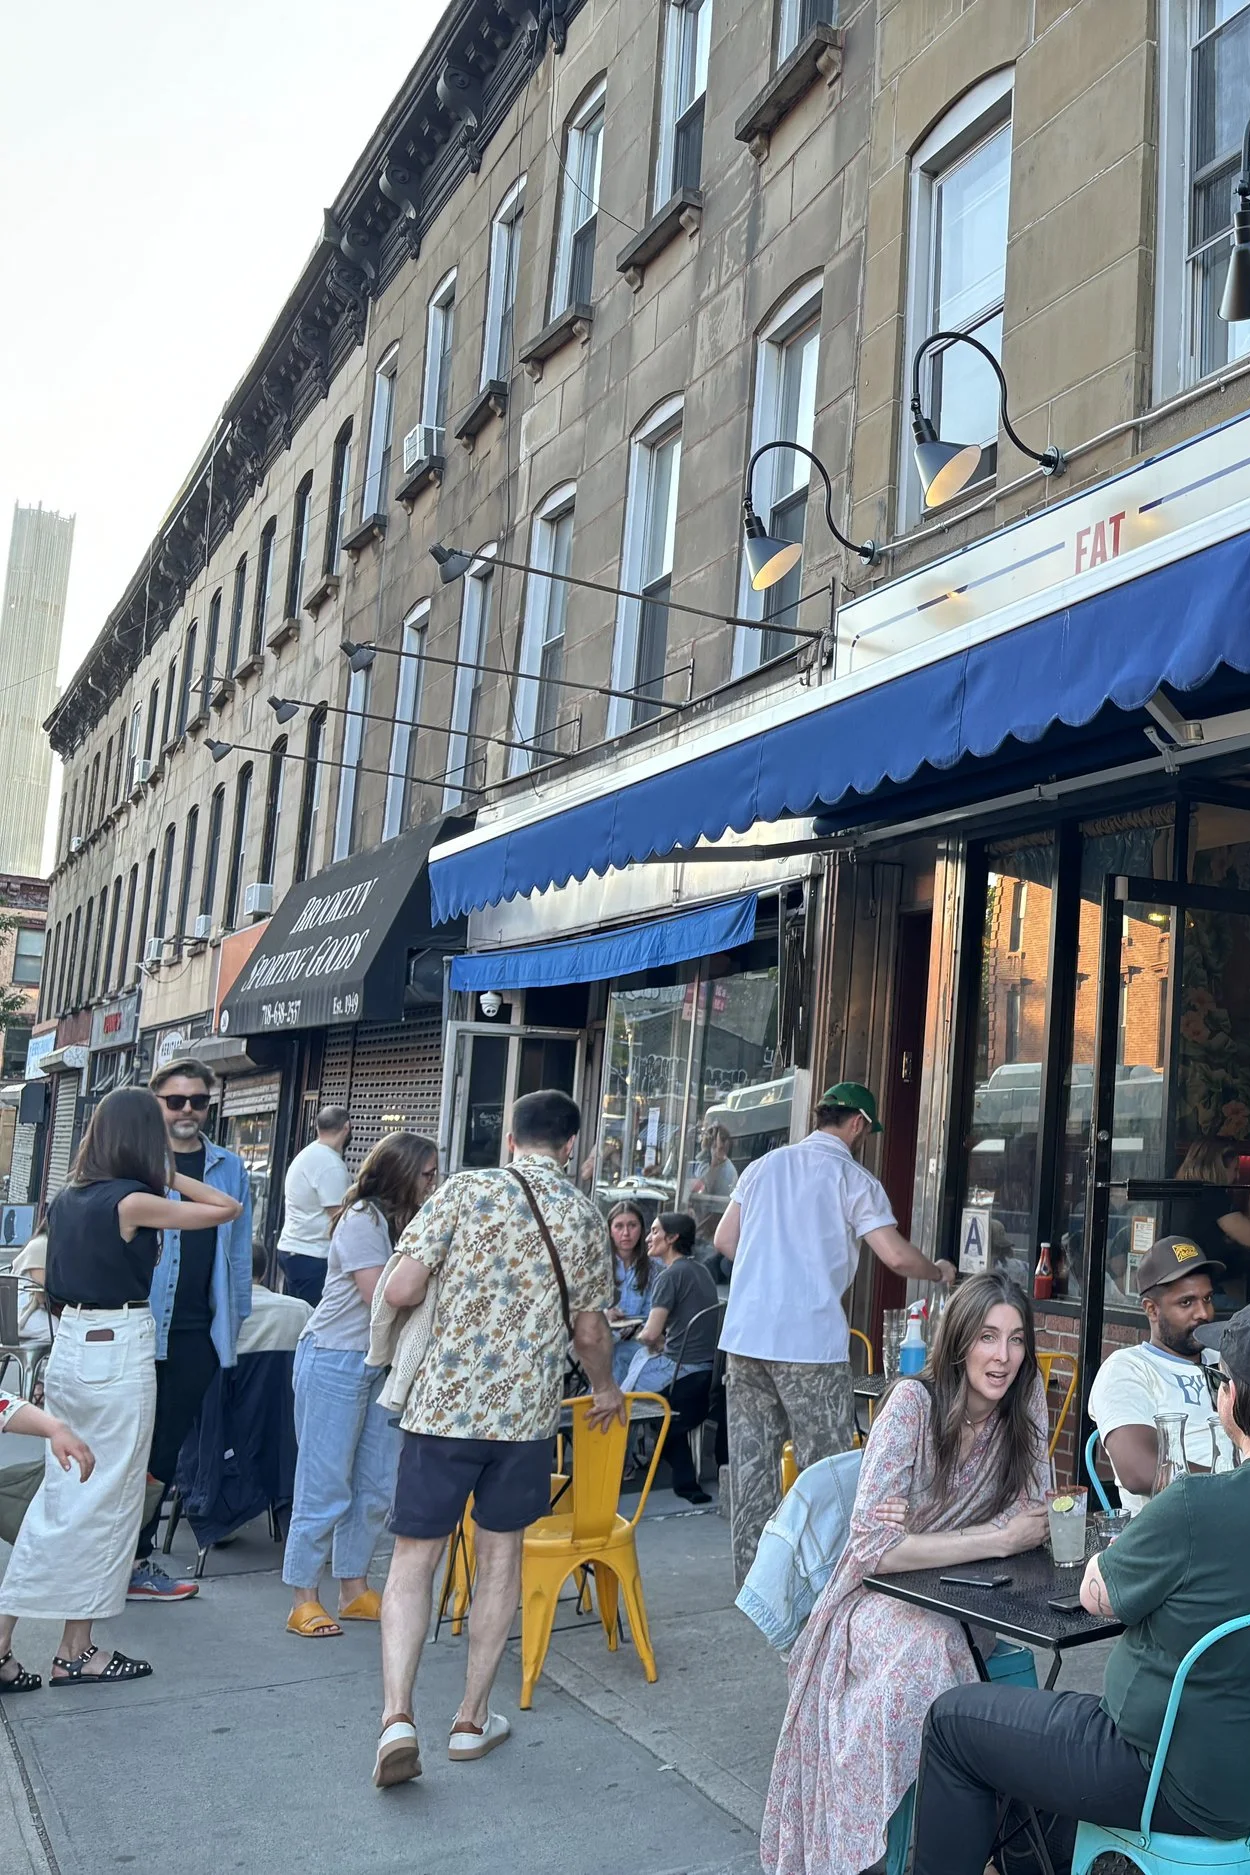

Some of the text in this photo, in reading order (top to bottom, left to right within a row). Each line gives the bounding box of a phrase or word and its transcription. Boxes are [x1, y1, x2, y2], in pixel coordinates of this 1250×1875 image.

[1075, 510, 1126, 575] FAT
[289, 877, 379, 935] BROOKLYN
[241, 928, 370, 992] SPORTING GOODS
[344, 992, 359, 1016] 1949
[963, 1216, 983, 1256] A
